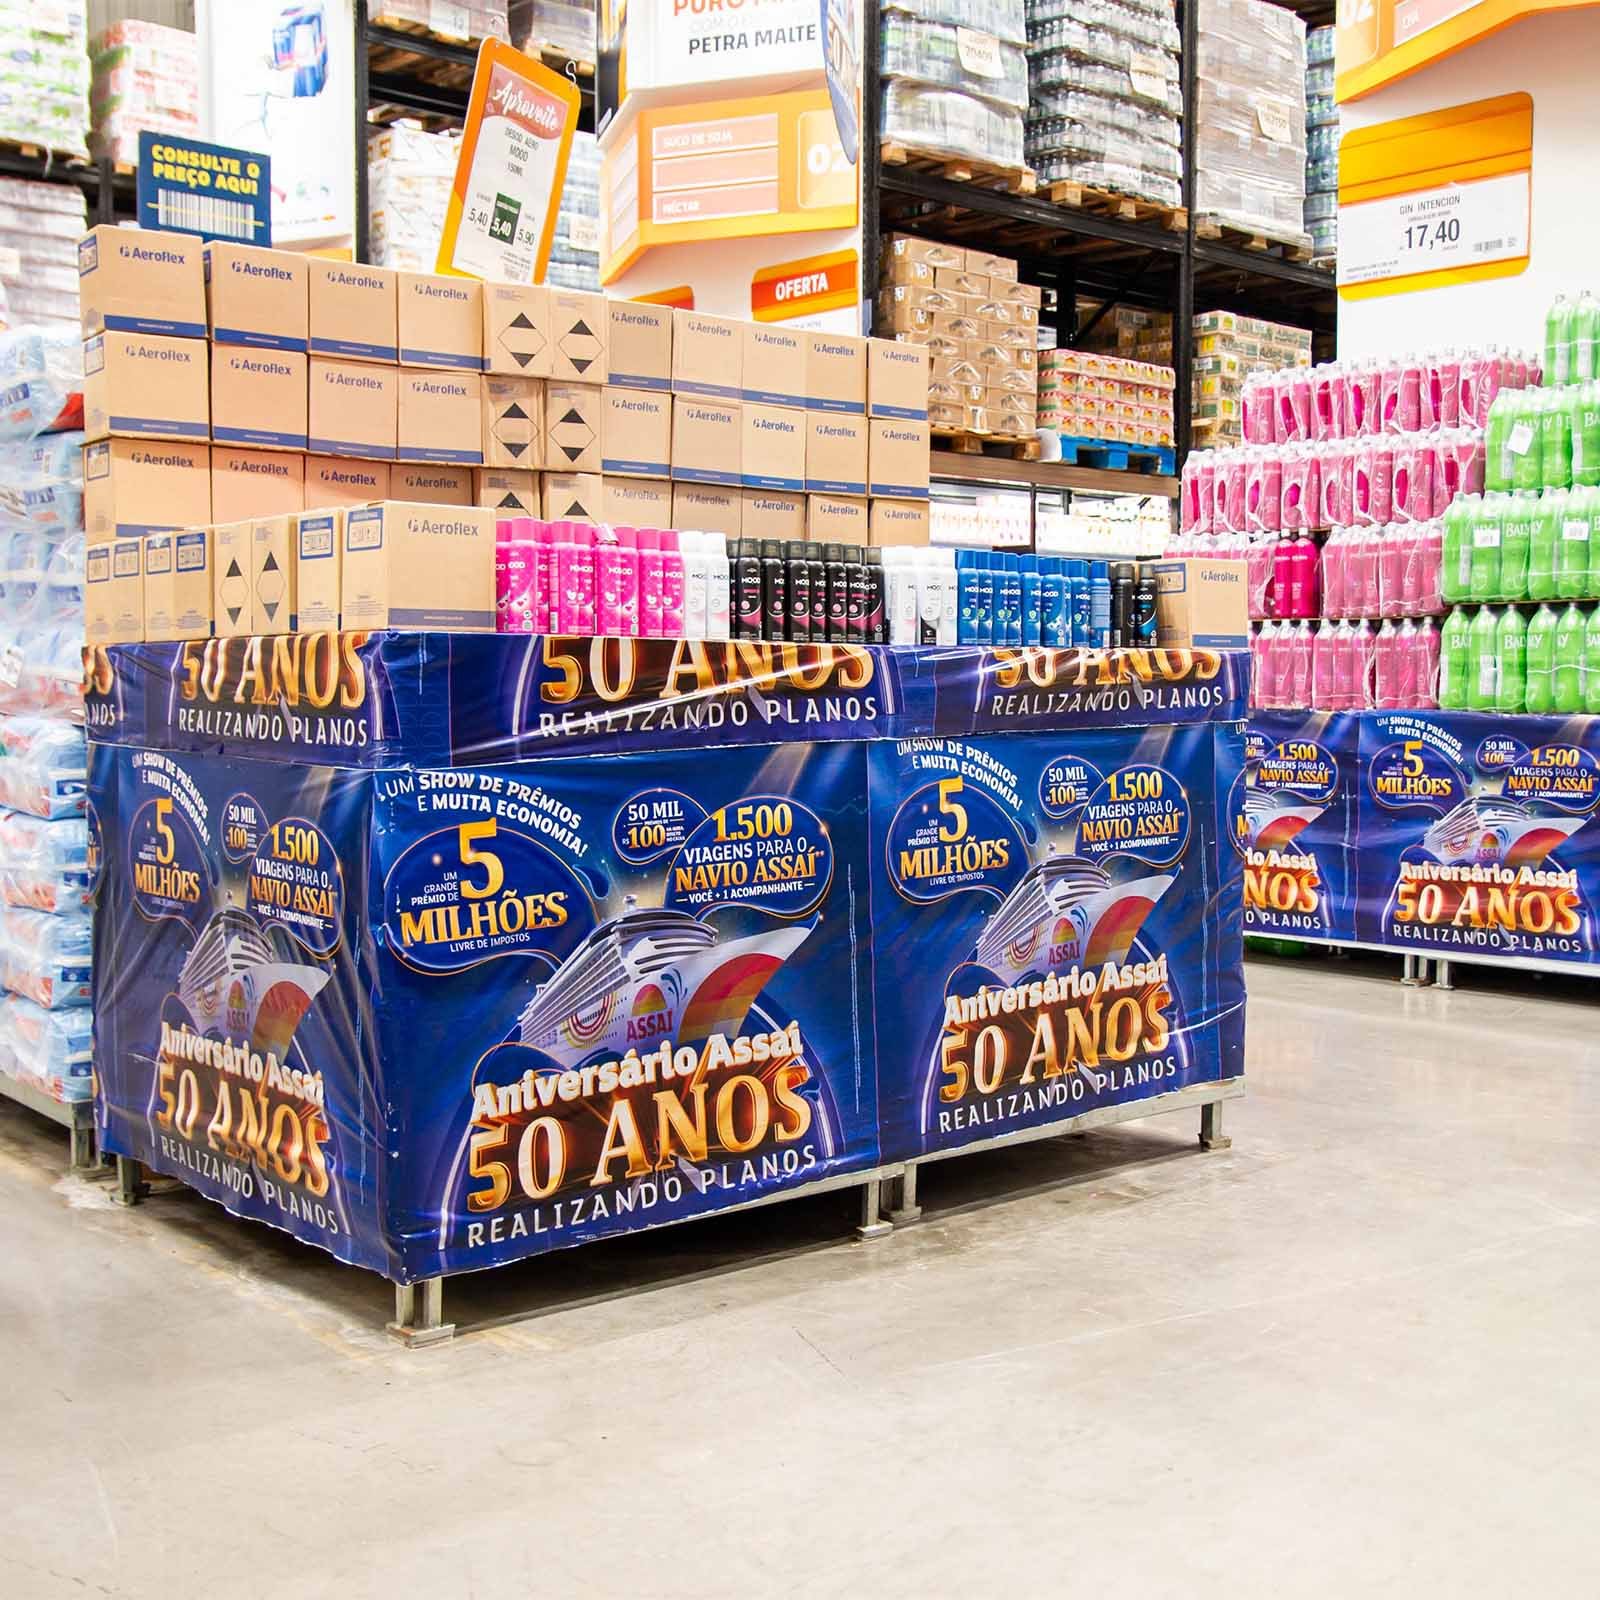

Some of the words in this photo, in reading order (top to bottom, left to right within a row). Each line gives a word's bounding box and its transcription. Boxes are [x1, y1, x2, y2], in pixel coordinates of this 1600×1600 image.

[688, 32, 749, 55] PETRA
[754, 24, 817, 47] MALTE
[492, 79, 560, 131] Aproveite
[151, 144, 241, 176] CONSULTE
[246, 162, 260, 179] O
[152, 161, 211, 189] PREÇO
[215, 173, 258, 196] AQUI
[467, 208, 489, 226] 5,40
[1399, 204, 1414, 216] GIN
[1417, 195, 1461, 213] INTENCION
[491, 217, 512, 238] 5,40
[1404, 218, 1461, 250] 17,40
[132, 247, 185, 265] Aeroflex
[243, 263, 293, 280] Aeroflex
[338, 272, 384, 290] Aeroflex
[775, 272, 829, 301] OFERTA
[620, 312, 660, 327] Aeroflex
[138, 345, 191, 362] Aeroflex
[822, 342, 855, 357] Aeroflex
[242, 358, 292, 376] Aeroflex
[422, 381, 467, 396] Aeroflex
[761, 418, 795, 433] Aeroflex
[143, 452, 194, 468] Aeroflex
[331, 470, 377, 487] Aeroflex
[421, 518, 479, 536] Aeroflex
[233, 631, 369, 709] ANOS
[540, 635, 637, 704] 50
[992, 689, 1131, 716] REALIZANDO
[1144, 686, 1224, 709] PLANOS
[179, 708, 283, 742] REALIZANDO
[292, 719, 368, 747] PLANOS
[540, 700, 749, 738] REALIZANDO
[765, 697, 878, 725] PLANOS
[897, 740, 912, 756] UM
[912, 739, 944, 753] SHOW
[946, 741, 964, 756] DE
[965, 745, 1019, 788] PRÊMIOS
[1277, 743, 1318, 760] 1.500
[1403, 740, 1425, 778] 5
[1530, 748, 1581, 768] 1.500
[143, 751, 166, 770] SHOW
[166, 758, 177, 777] DE
[176, 763, 209, 818] PRÊMIOS
[912, 756, 920, 769] E
[920, 755, 959, 772] MUITA
[961, 762, 1024, 812] ECONOMIA!
[1107, 771, 1163, 802] 1.500
[1259, 769, 1294, 781] NAVIO
[1376, 772, 1453, 797] MILHÕES
[1507, 775, 1551, 791] NAVIO
[147, 769, 171, 793] MUITA
[171, 783, 212, 847] ECONOMIA!
[228, 804, 240, 823] 50
[240, 805, 257, 825] MIL
[385, 776, 415, 798] UM
[418, 772, 476, 791] SHOW
[479, 774, 504, 793] DE
[506, 780, 582, 830] PRÊMIOS
[628, 803, 649, 822] 50
[652, 800, 684, 819] MIL
[938, 775, 968, 843] 5
[155, 796, 175, 865] 5
[227, 827, 248, 849] 100
[417, 795, 428, 812] E
[432, 793, 492, 813] MUITA
[495, 799, 589, 858] ECONOMIA!
[627, 824, 666, 849] 100
[711, 803, 793, 843] 1.500
[1082, 816, 1133, 843] NAVIO
[1135, 807, 1179, 837] ASSAÍ
[270, 823, 319, 865] 1.500
[459, 816, 505, 899] 5
[683, 842, 753, 865] VIAGENS
[756, 839, 794, 857] PARA
[797, 837, 807, 853] O
[900, 835, 1010, 881] MILHÕES
[1269, 849, 1318, 870] Assaí
[135, 862, 200, 903] MILHÕES
[255, 857, 294, 883] VIAGENS
[295, 863, 318, 886] PARA
[320, 871, 328, 888] O
[443, 871, 458, 882] UM
[674, 860, 748, 893] NAVIO
[753, 847, 817, 884] ASSAÍ
[1399, 860, 1515, 884] Aniversário
[1519, 865, 1579, 890] Assaí
[251, 875, 291, 907] NAVIO
[293, 884, 335, 918] ASSAÍ
[411, 893, 446, 907] PRÊMIO
[447, 891, 460, 902] DE
[423, 881, 459, 894] GRANDE
[689, 889, 714, 905] VOCÊ
[723, 889, 729, 900] 1
[730, 880, 804, 899] ACOMPANHANTE
[400, 889, 568, 948] MILHÕES
[1260, 912, 1321, 929] PLANOS
[1394, 883, 1444, 925] 50
[1450, 885, 1582, 936] ANOS
[450, 941, 476, 953] LIVRE
[477, 939, 489, 949] DE
[491, 932, 531, 947] IMPOSTOS
[1393, 924, 1501, 947] REALIZANDO
[1509, 935, 1583, 954] PLANOS
[944, 965, 1097, 1027] Aniversário
[1102, 952, 1169, 992] Assaí
[625, 1008, 674, 1043] ASSAI
[160, 1021, 264, 1083] Aniversário
[267, 1051, 325, 1103] Assaí
[940, 1024, 1008, 1104] 50
[1019, 990, 1173, 1085] ANOS
[472, 1038, 698, 1123] Aniversário
[707, 1019, 805, 1070] Assaí
[939, 1080, 1085, 1134] REALIZANDO
[1096, 1055, 1177, 1096] PLANOS
[155, 1058, 199, 1140] 50
[207, 1079, 331, 1198] ANOS
[466, 1114, 567, 1213] 50
[590, 1064, 813, 1187] ANOS
[161, 1135, 253, 1199] REALIZANDO
[263, 1179, 339, 1235] PLANOS
[468, 1176, 683, 1249] REALIZANDO
[700, 1143, 817, 1195] PLANOS
